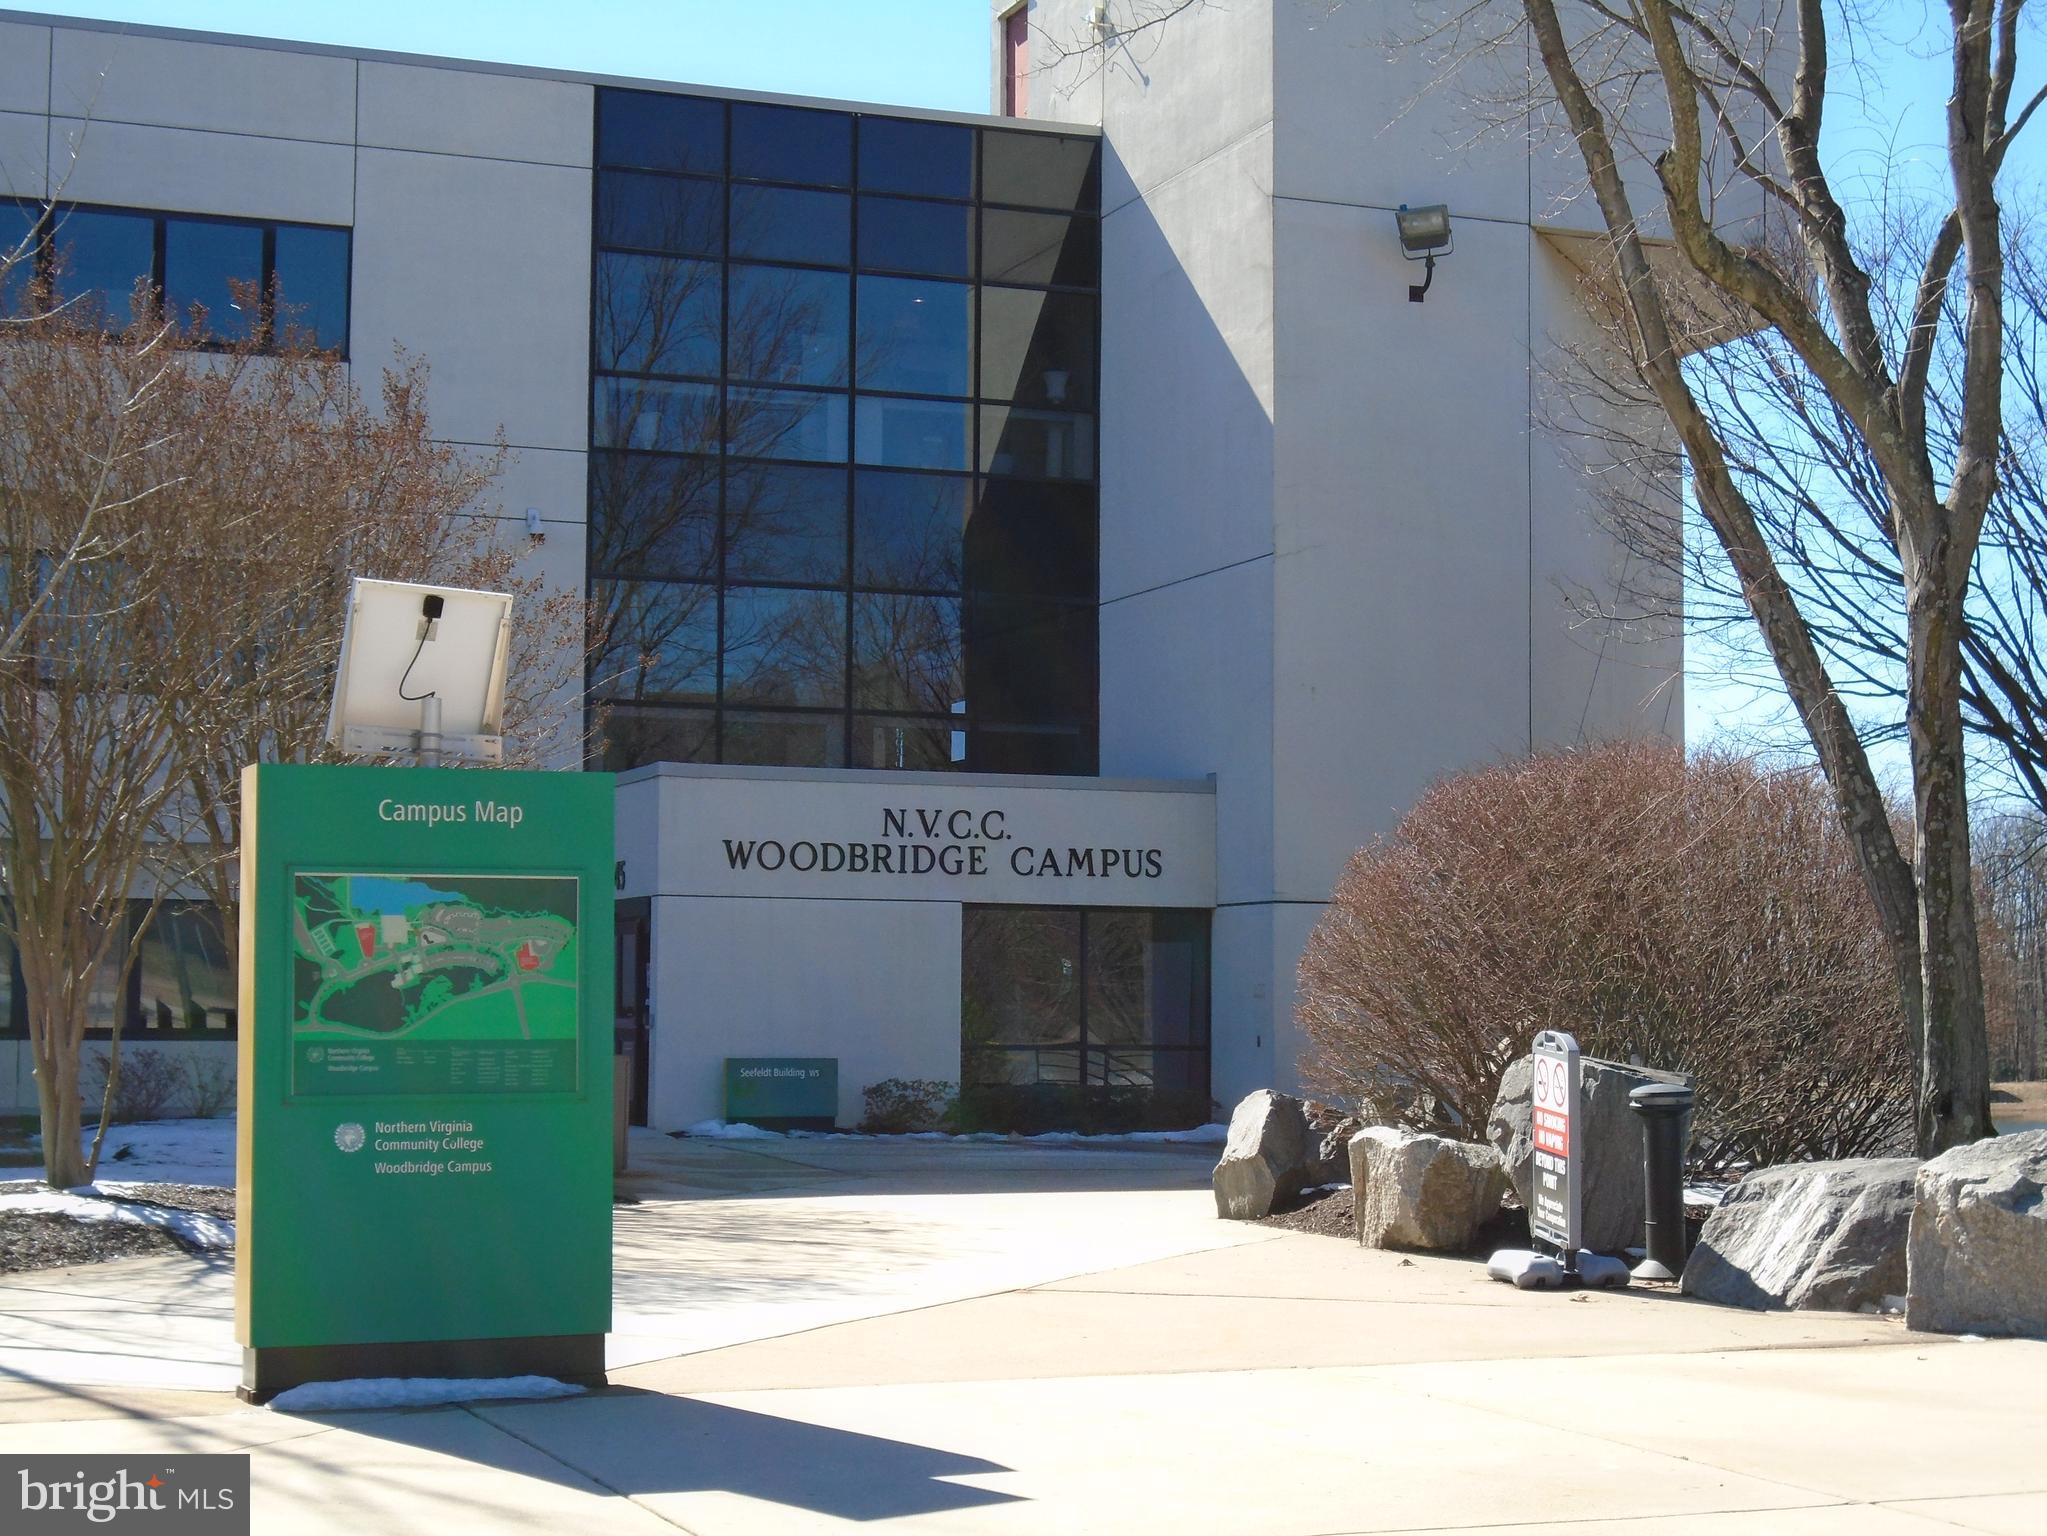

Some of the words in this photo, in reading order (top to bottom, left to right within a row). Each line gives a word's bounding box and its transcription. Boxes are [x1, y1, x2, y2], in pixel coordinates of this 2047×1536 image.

[378, 799, 467, 828] Campus
[474, 800, 524, 829] Map
[882, 808, 1012, 841] N.V.C.C.
[722, 839, 988, 876] WOODBRIDGE
[1010, 846, 1163, 879] CAMPUS
[773, 1067, 806, 1079] Building
[375, 1121, 426, 1134] Northern
[430, 1120, 473, 1135] Virginia
[375, 1139, 439, 1152] Community
[442, 1138, 484, 1152] College
[375, 1161, 444, 1176] Woodbridge
[447, 1160, 492, 1174] Campus
